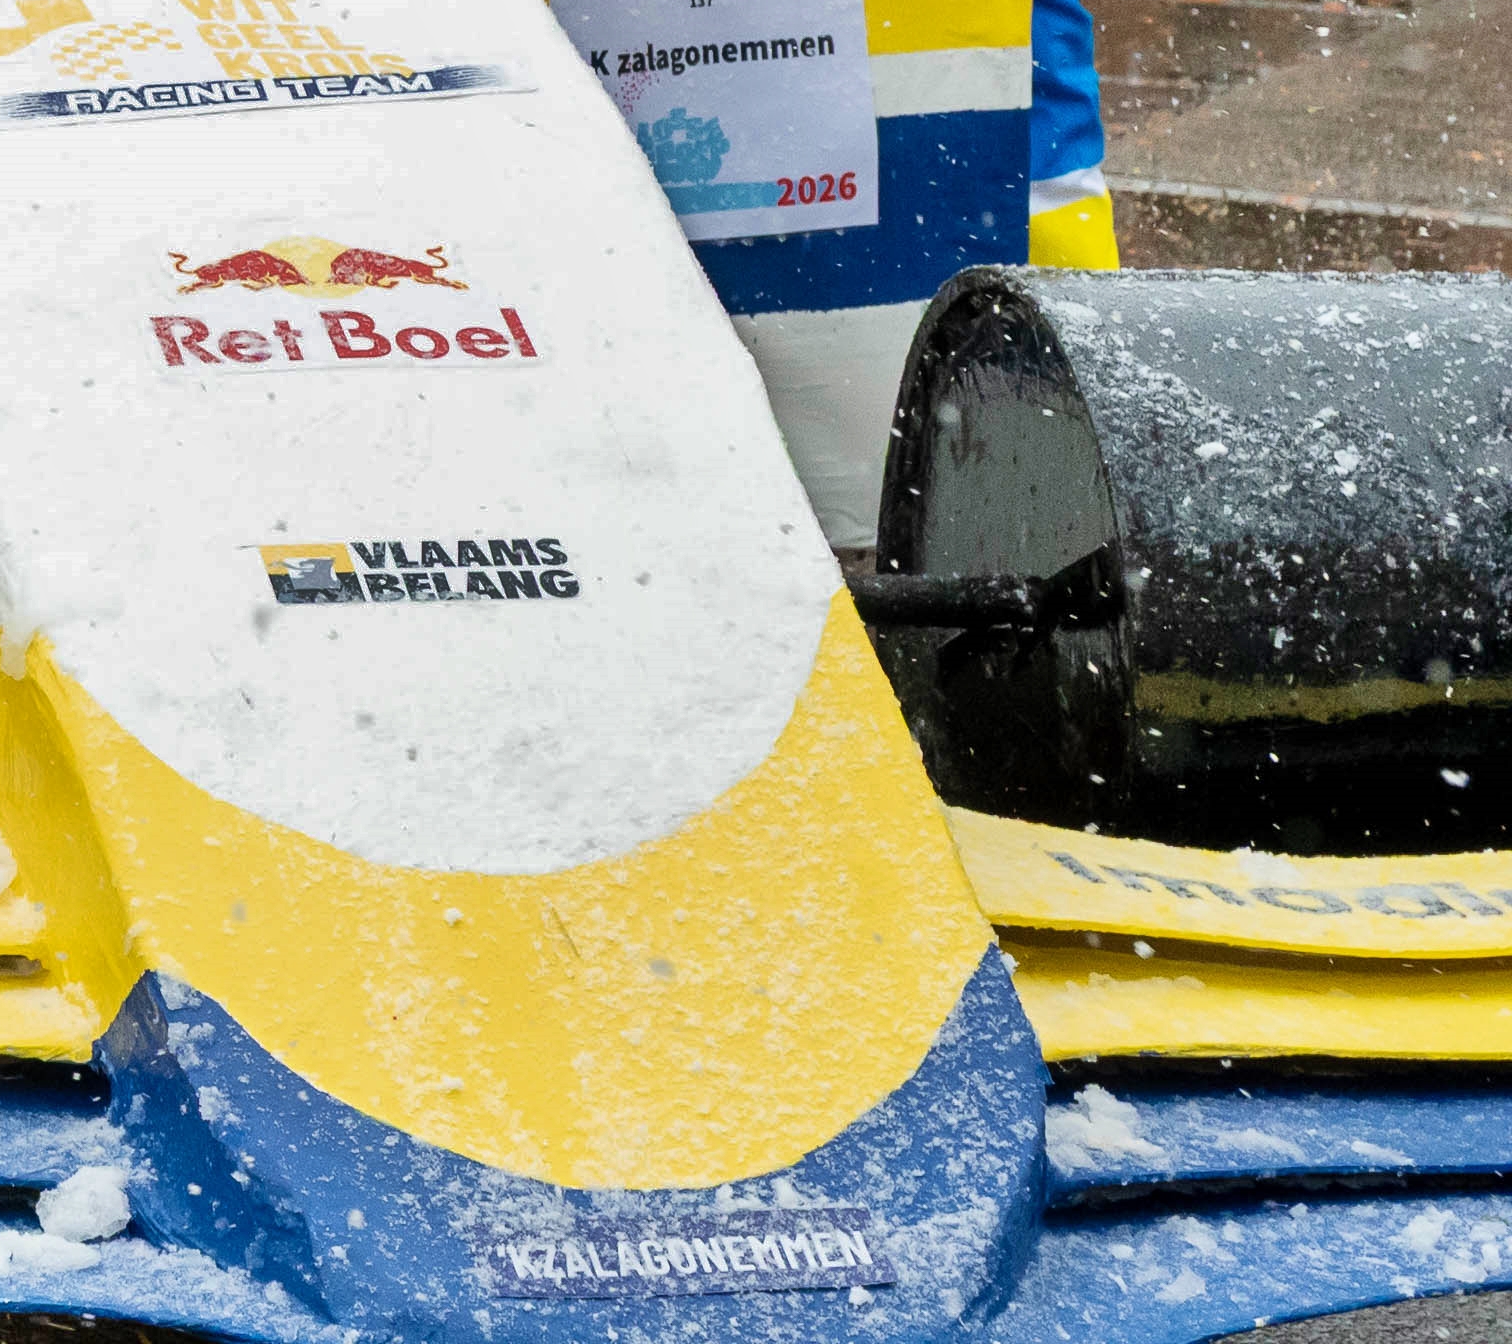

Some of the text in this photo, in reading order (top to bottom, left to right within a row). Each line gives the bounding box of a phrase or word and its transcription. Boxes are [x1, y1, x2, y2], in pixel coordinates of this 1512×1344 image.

[196, 23, 364, 50] GEEL
[618, 29, 836, 77] zalagonemmen
[213, 51, 415, 78] KROIS
[64, 73, 433, 113] RACING TEAM
[776, 172, 858, 208] 2026
[149, 307, 538, 369] Ret Boel
[350, 538, 570, 570] VLAAMS
[365, 571, 580, 602] BELANG
